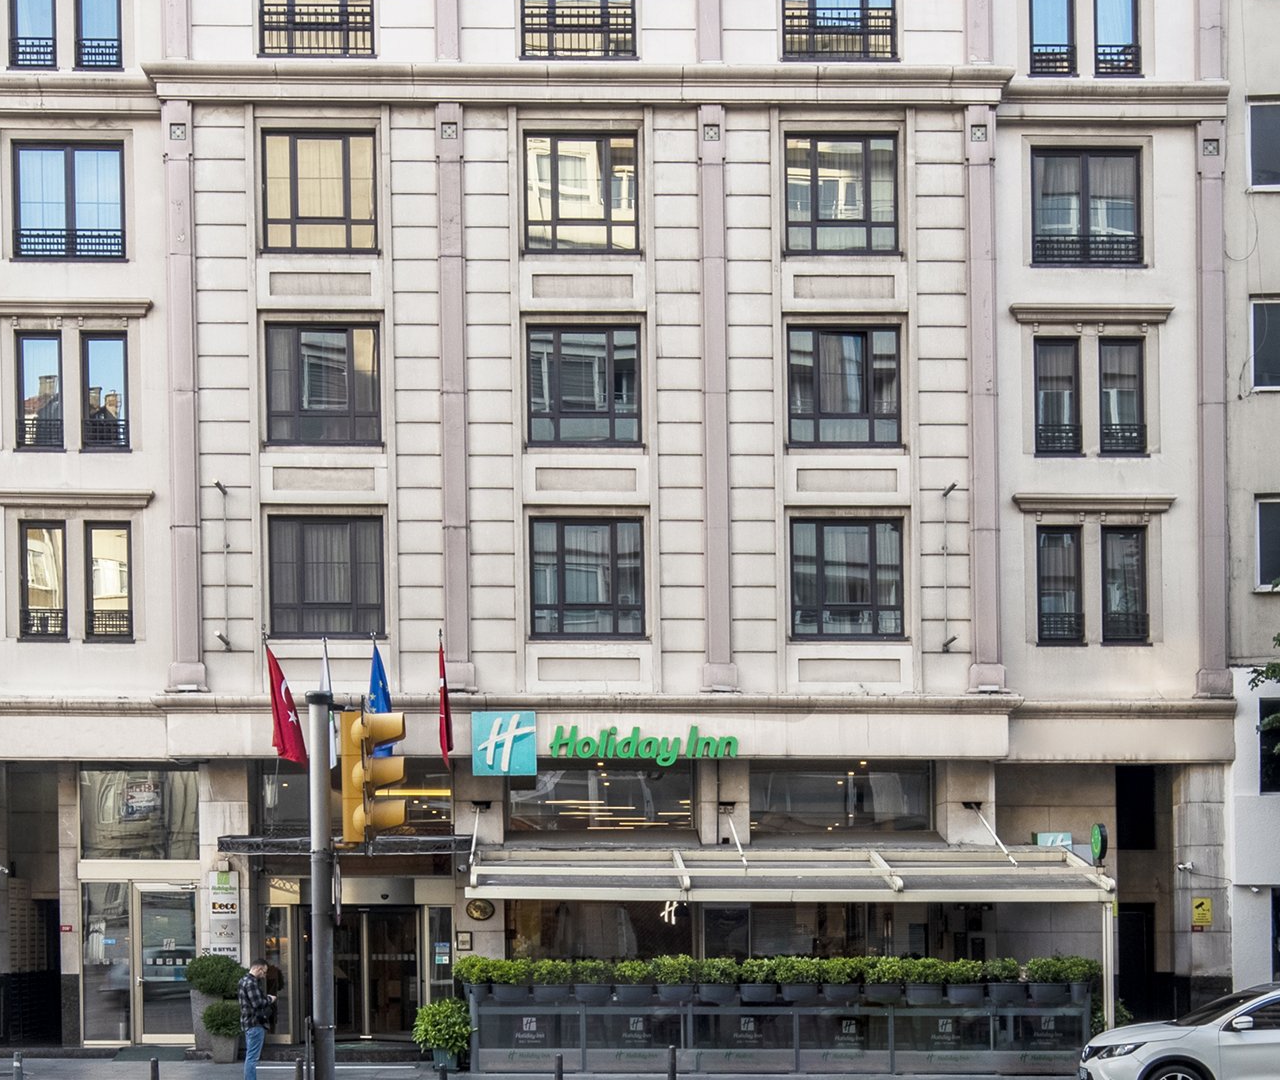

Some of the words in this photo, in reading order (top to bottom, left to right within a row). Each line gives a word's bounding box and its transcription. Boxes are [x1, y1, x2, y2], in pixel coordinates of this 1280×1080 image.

[549, 725, 681, 767] Holiday
[685, 725, 739, 759] Inn
[211, 902, 238, 911] Deco
